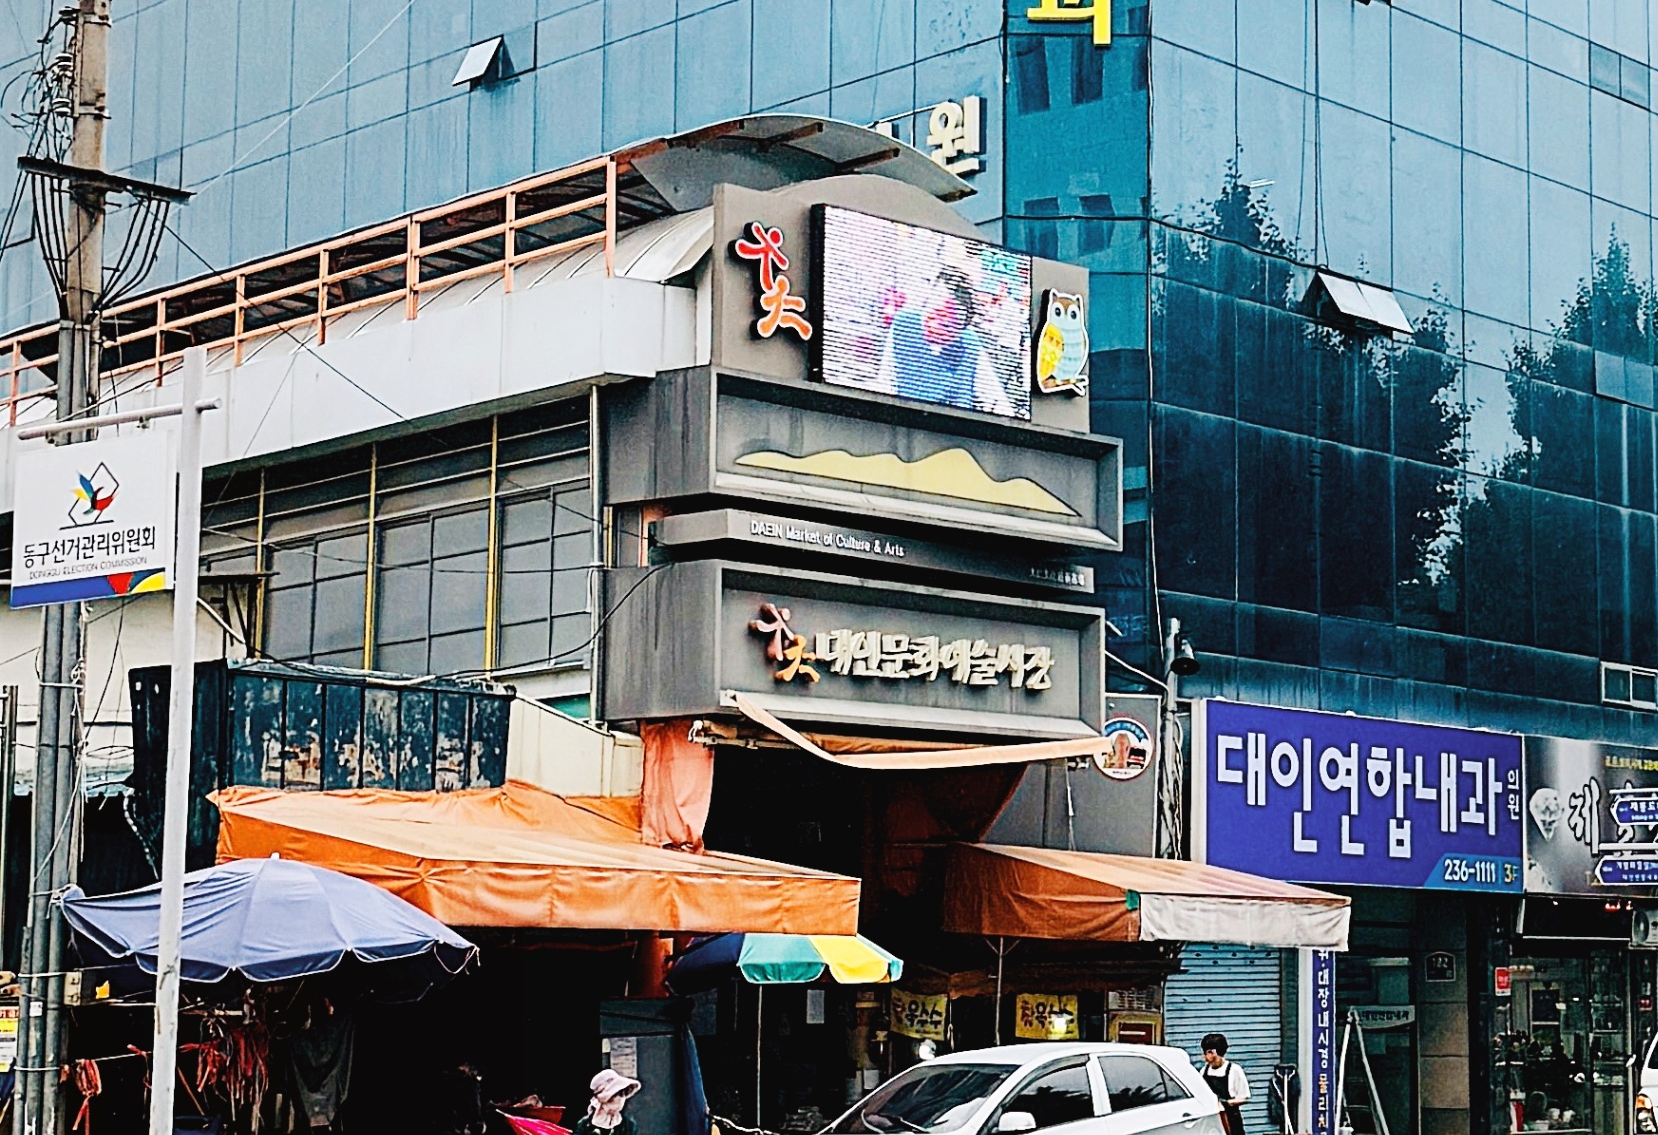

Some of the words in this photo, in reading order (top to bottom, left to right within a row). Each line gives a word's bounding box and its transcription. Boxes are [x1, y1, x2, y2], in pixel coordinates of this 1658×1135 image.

[23, 525, 156, 569] 동구선거관리위원회
[750, 519, 783, 538] DAEIN
[786, 525, 822, 545] Market
[823, 532, 833, 546] of
[835, 534, 871, 552] Culture
[873, 539, 882, 554] &
[884, 541, 905, 557] Arts
[815, 627, 1054, 691] 대인문화예술시장
[1216, 731, 1503, 859] 대인연합내과
[1507, 768, 1520, 820] 의원
[1444, 858, 1496, 883] 236-1111
